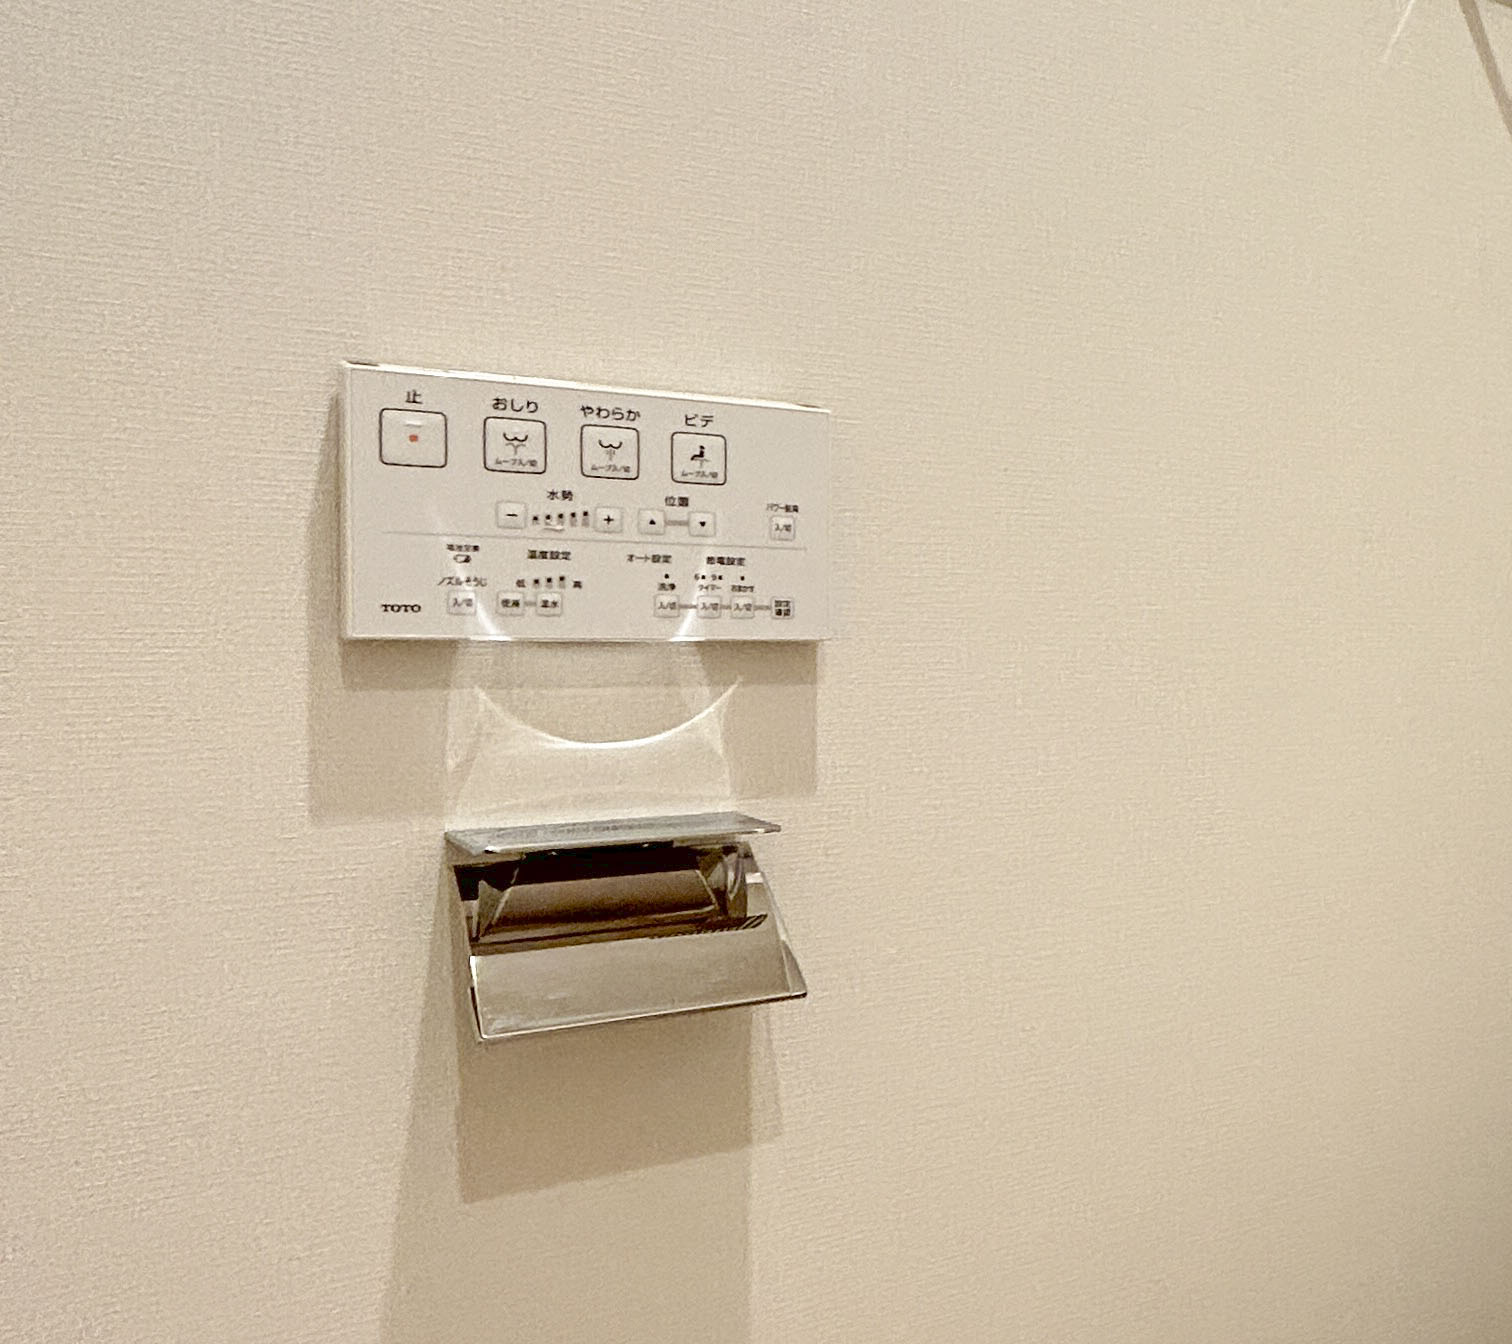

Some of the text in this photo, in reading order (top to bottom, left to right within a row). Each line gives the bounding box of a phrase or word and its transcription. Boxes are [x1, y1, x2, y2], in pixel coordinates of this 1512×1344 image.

[405, 391, 422, 404] 止
[492, 397, 538, 413] おしり
[580, 404, 641, 422] やわらか
[381, 603, 421, 613] TOTO
